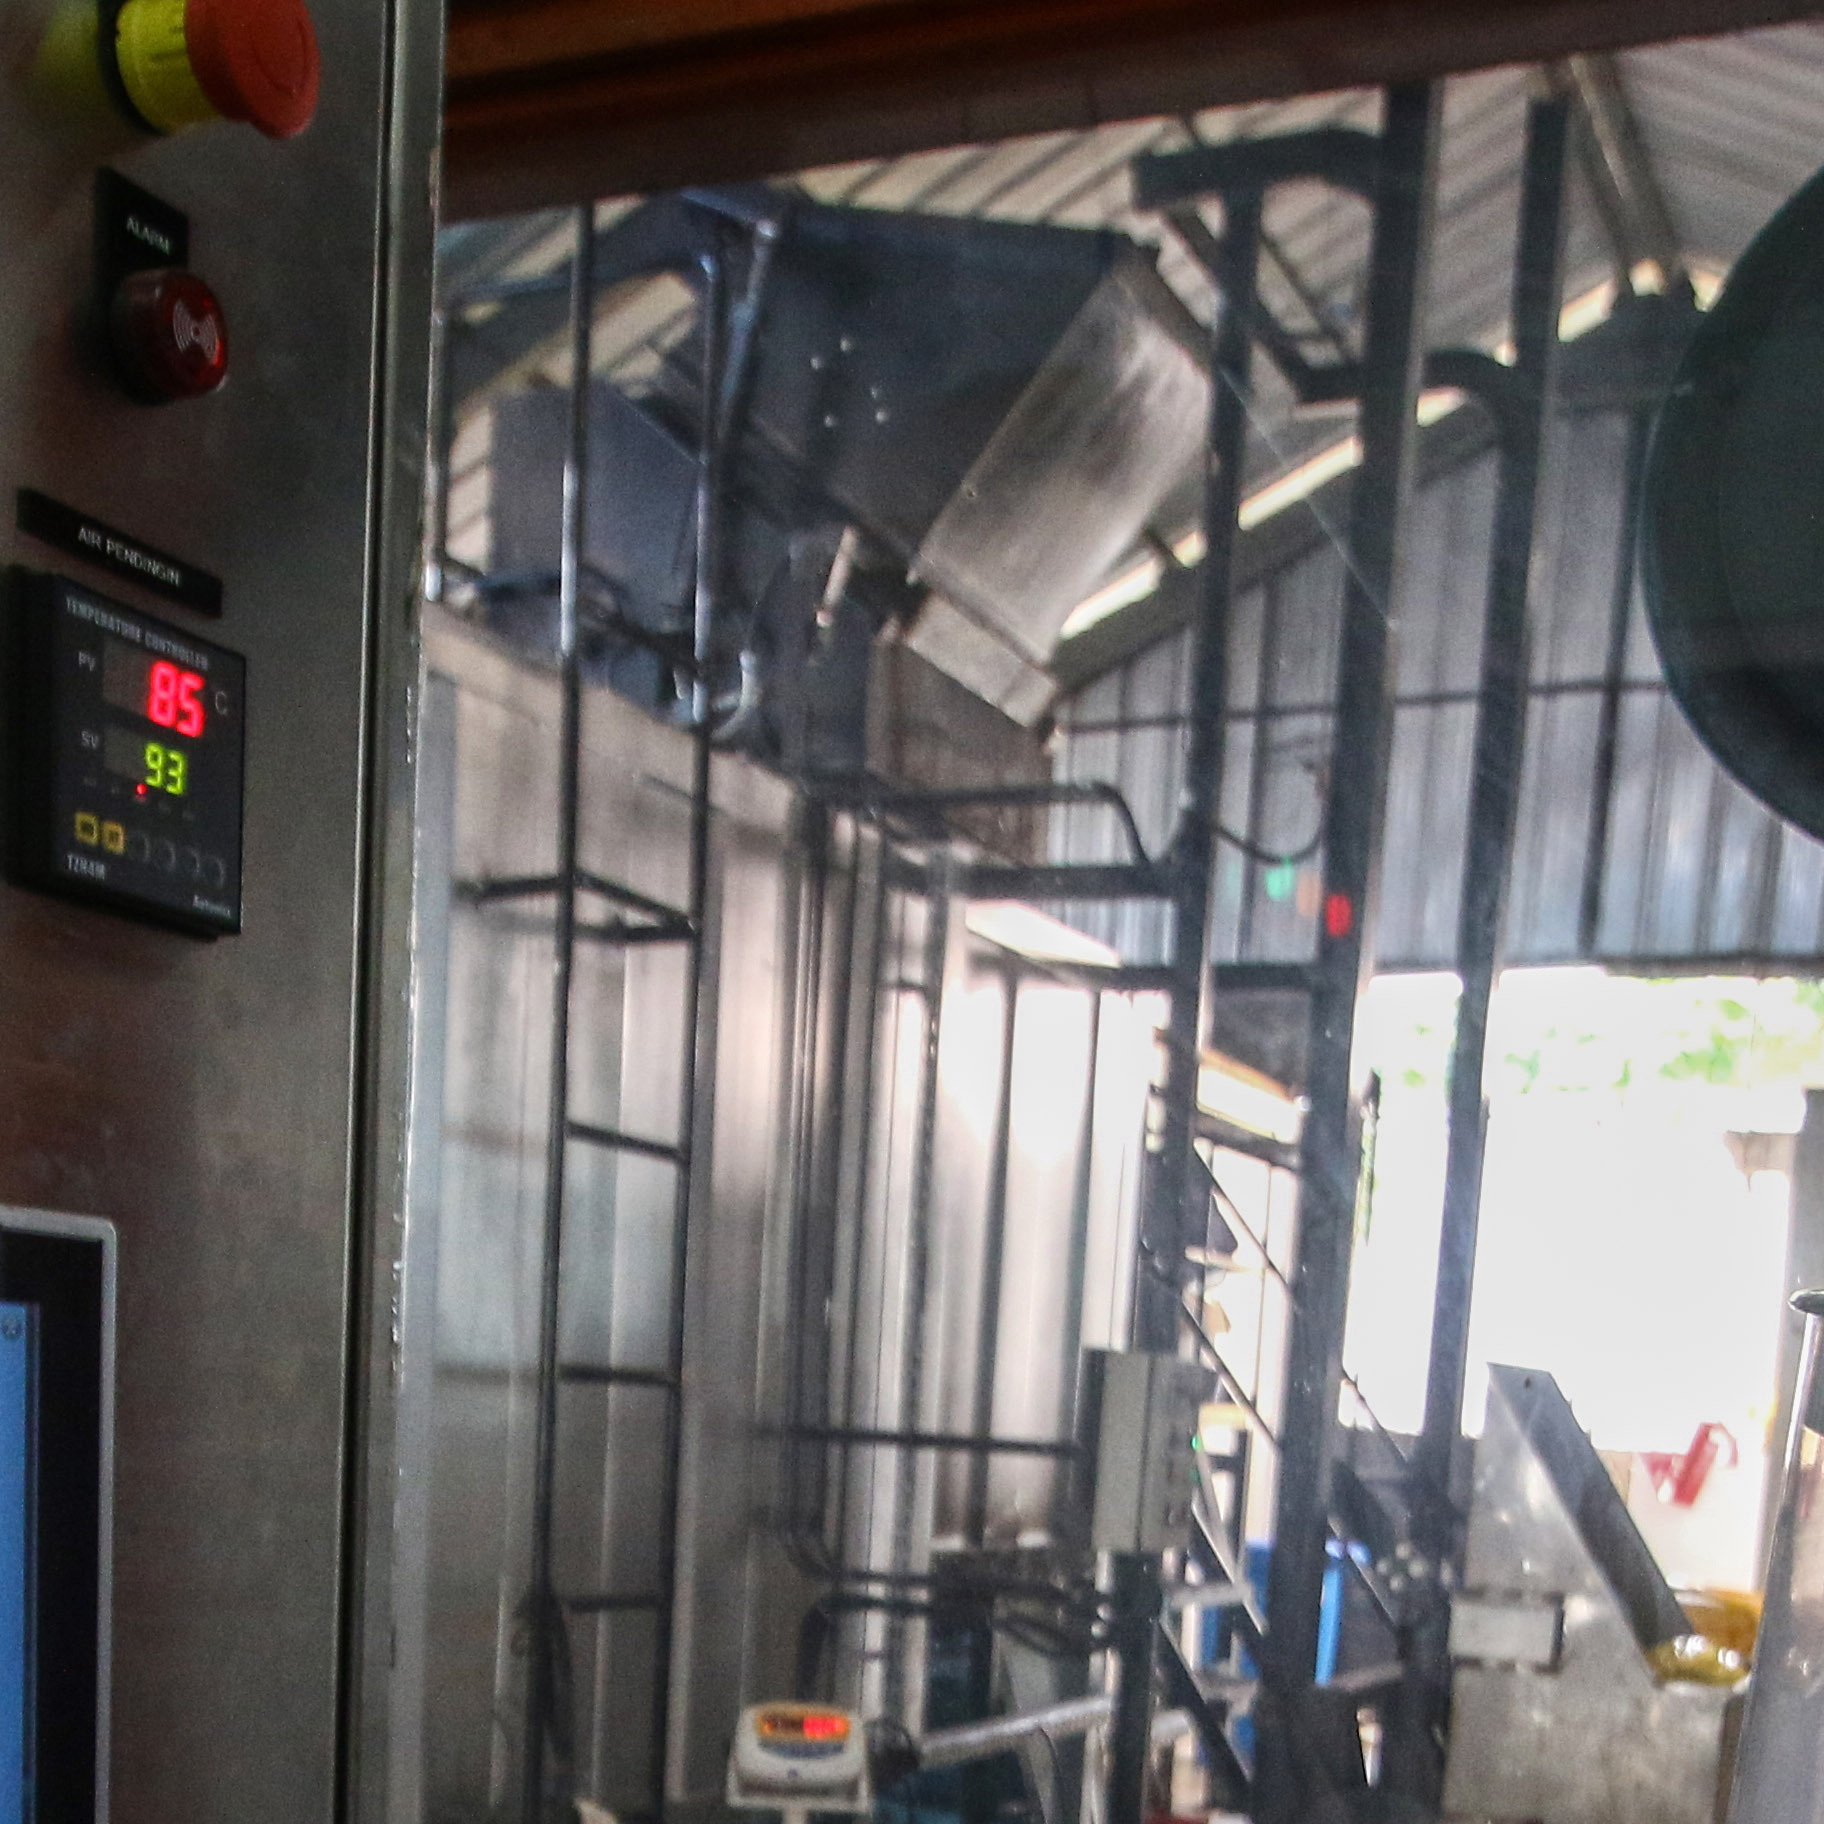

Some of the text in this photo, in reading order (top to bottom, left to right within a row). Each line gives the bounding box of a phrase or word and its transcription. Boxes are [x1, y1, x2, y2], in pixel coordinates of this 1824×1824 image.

[126, 216, 170, 256] ALARM
[78, 526, 180, 588] AIR PENDINGIN
[147, 659, 206, 738] 85
[143, 740, 189, 797] 93
